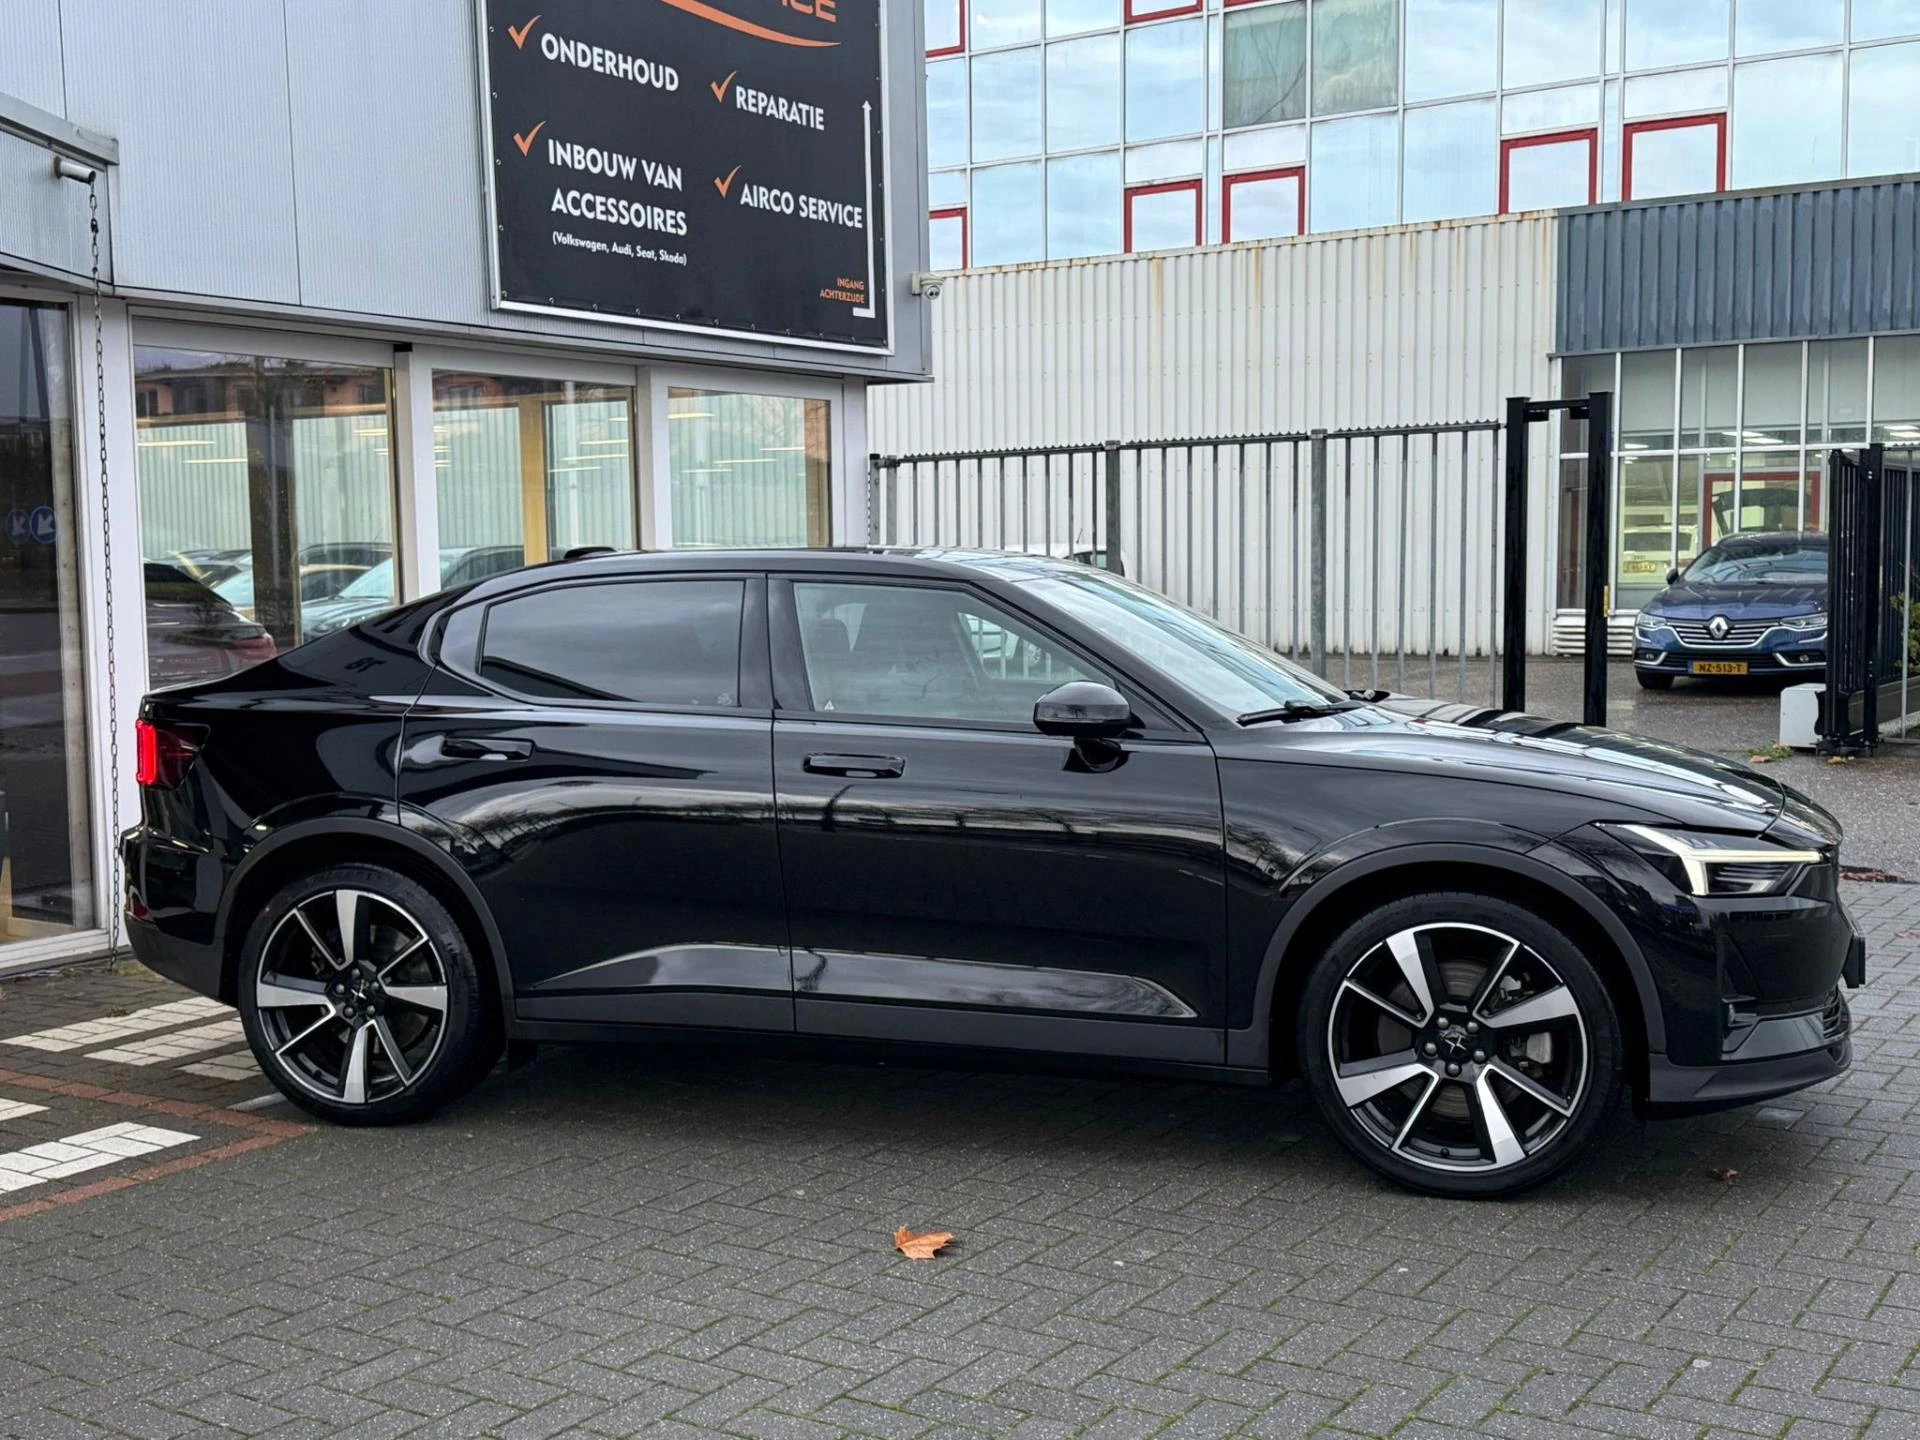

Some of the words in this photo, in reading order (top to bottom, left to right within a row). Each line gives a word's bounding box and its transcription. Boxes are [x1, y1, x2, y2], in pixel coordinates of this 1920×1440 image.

[541, 32, 679, 92] ONDERHOUD
[735, 85, 825, 131] REPARATIE
[548, 138, 637, 181] INBOUW
[641, 159, 683, 192] VAN
[551, 187, 688, 236] ACCESSOIRES
[740, 183, 795, 215] AIRCO
[799, 195, 863, 229] SERVICE
[552, 231, 609, 253] (Volkswagen,
[611, 242, 634, 258] Audi,
[635, 245, 658, 262] Seat,
[659, 249, 687, 266] Skoda)
[836, 277, 865, 290] INGANG
